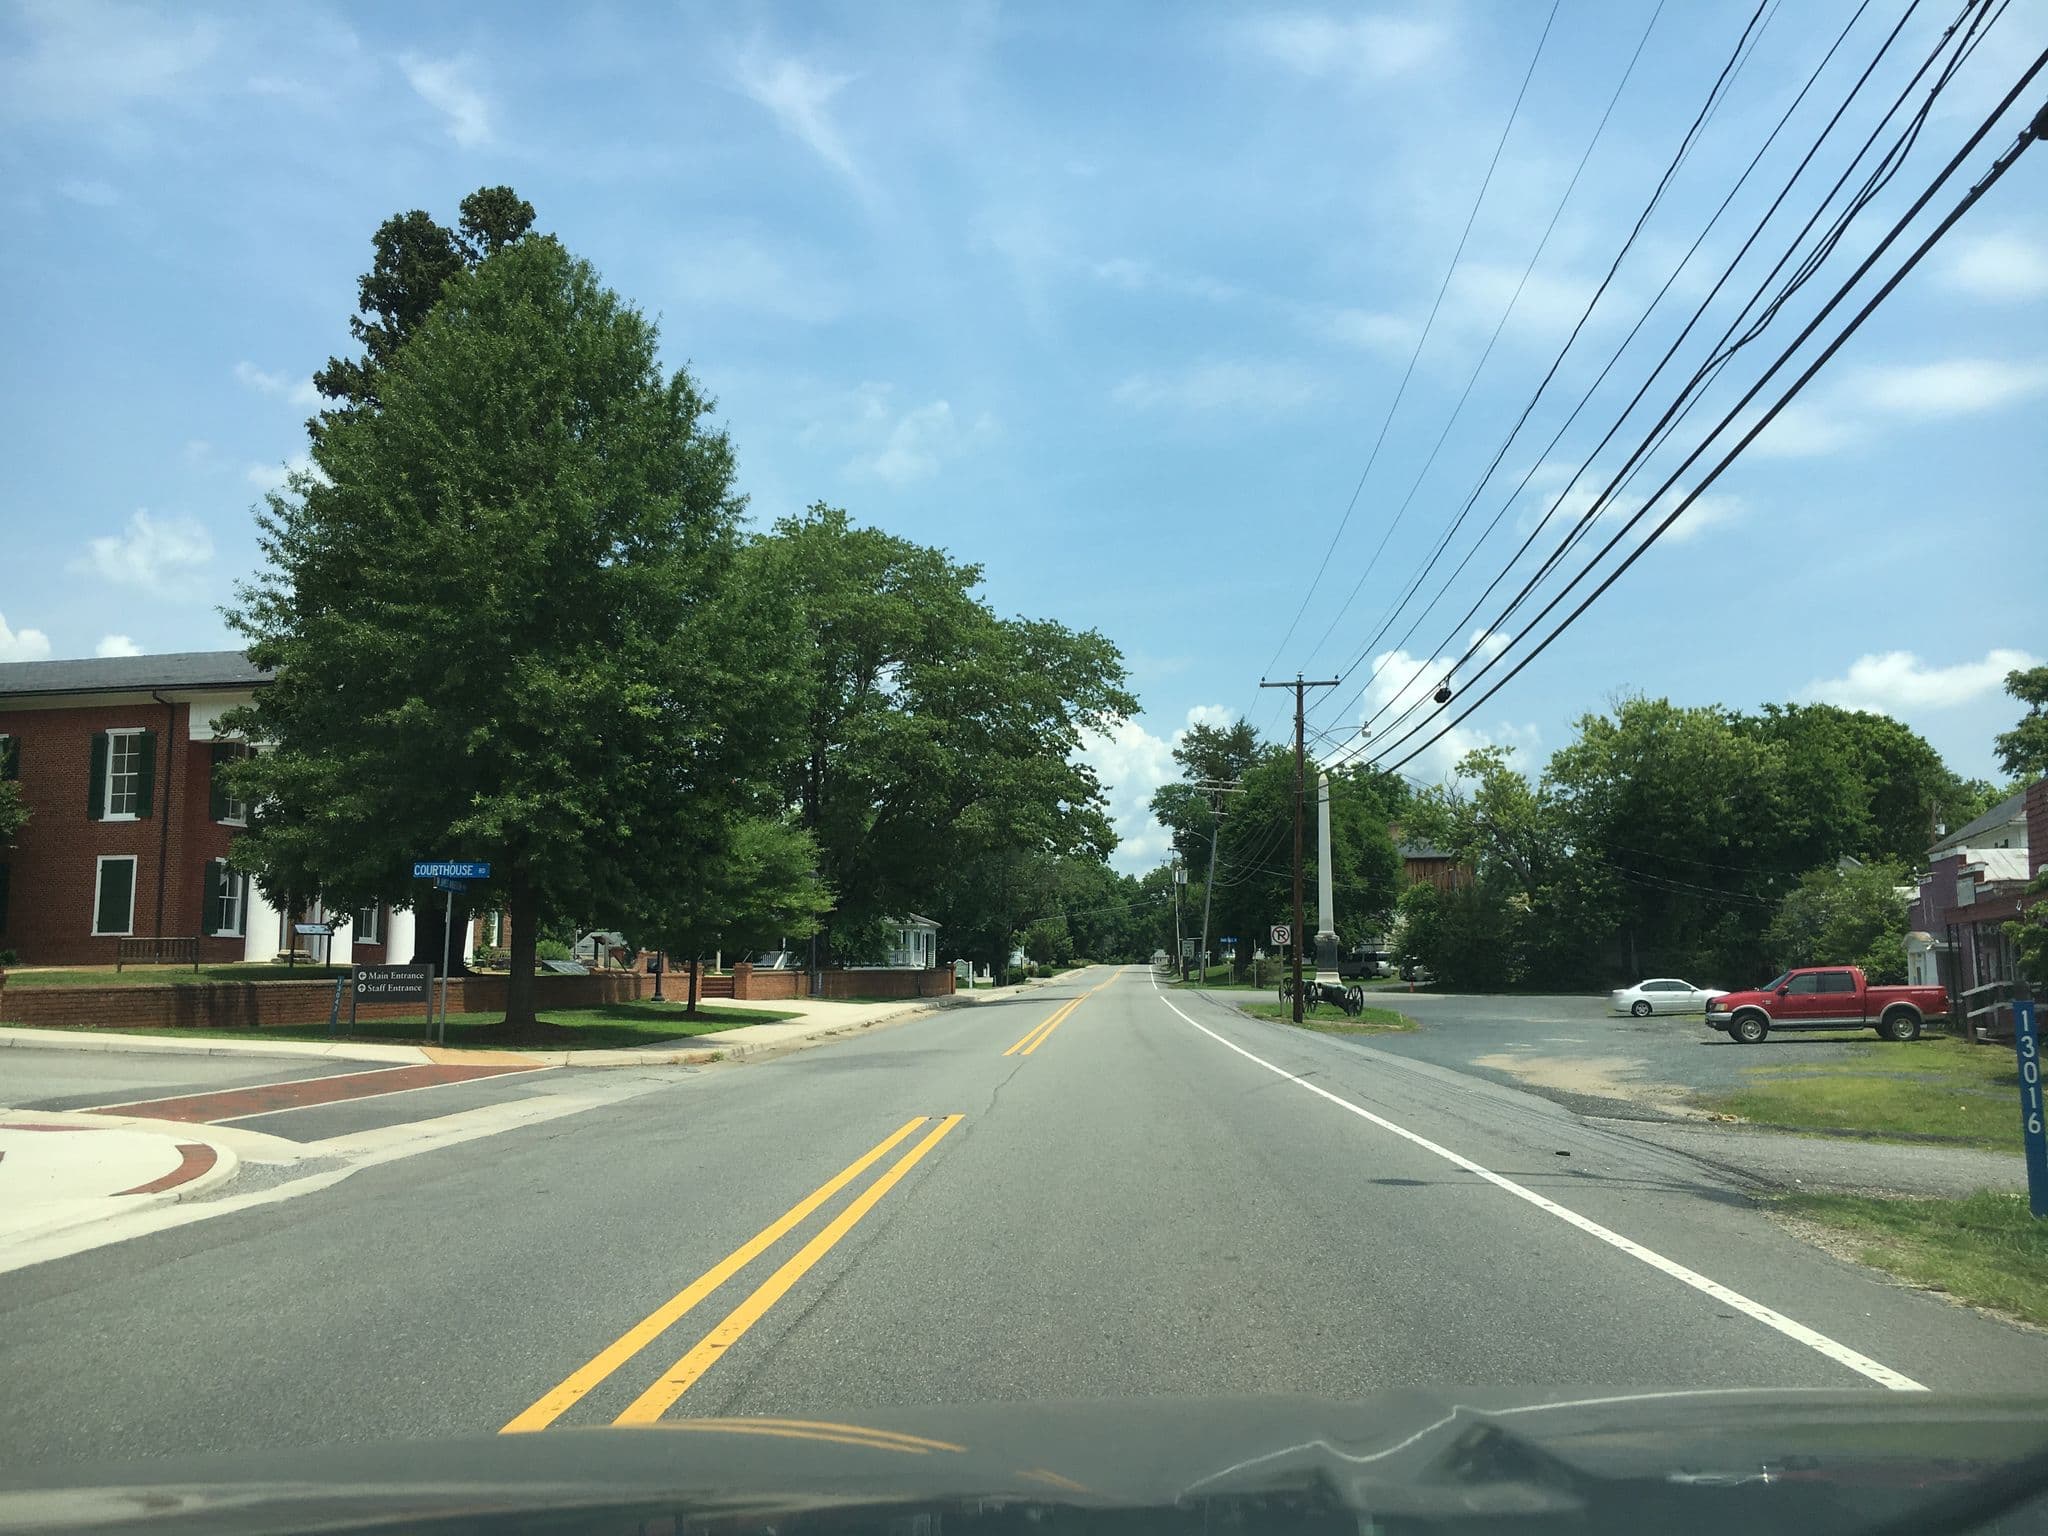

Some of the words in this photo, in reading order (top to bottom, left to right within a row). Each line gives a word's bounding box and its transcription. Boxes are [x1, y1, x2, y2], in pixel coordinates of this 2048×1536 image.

[414, 864, 474, 876] COURTHOUSE
[368, 971, 389, 980] Main
[390, 971, 425, 980] Entrance
[367, 983, 386, 992] Staff
[387, 983, 423, 992] Entrance
[2020, 1009, 2041, 1134] 13016
